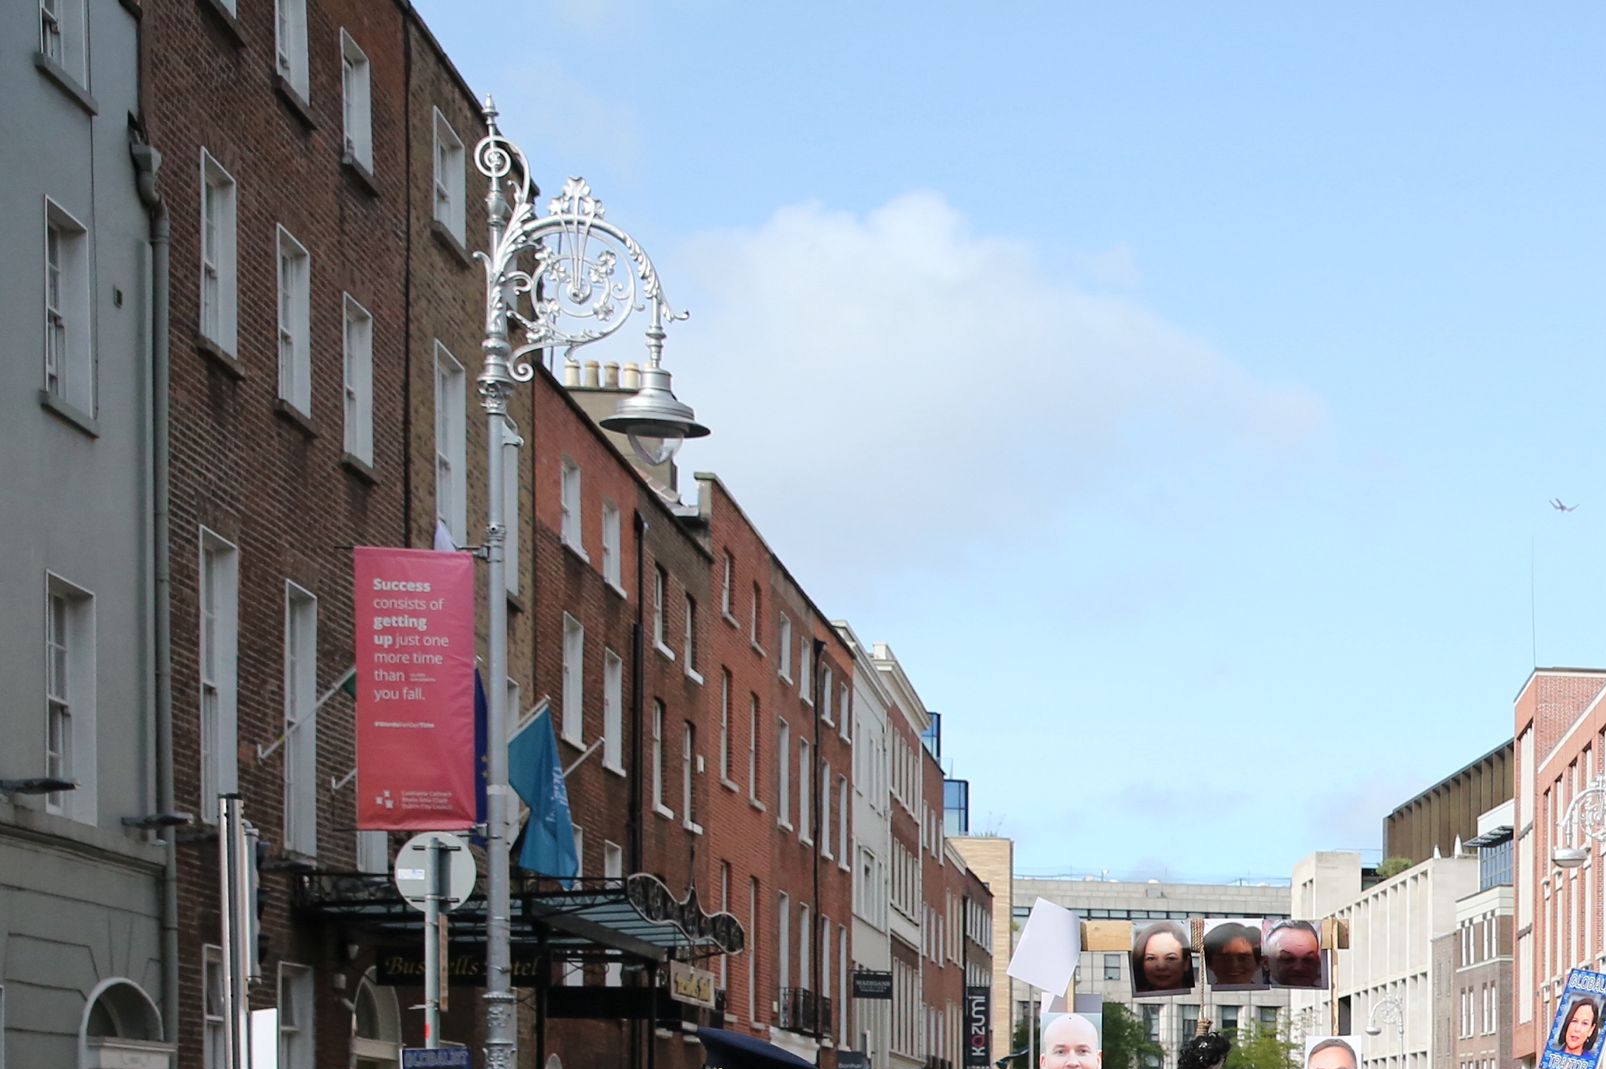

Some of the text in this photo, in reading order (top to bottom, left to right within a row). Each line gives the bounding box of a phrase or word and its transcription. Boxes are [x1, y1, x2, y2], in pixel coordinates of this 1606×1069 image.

[373, 578, 431, 592] Success
[373, 598, 444, 610] consists of
[373, 615, 427, 631] getting
[374, 634, 449, 649] up just one
[374, 652, 443, 665] more time
[374, 669, 405, 682] than
[374, 687, 425, 702] you fall.
